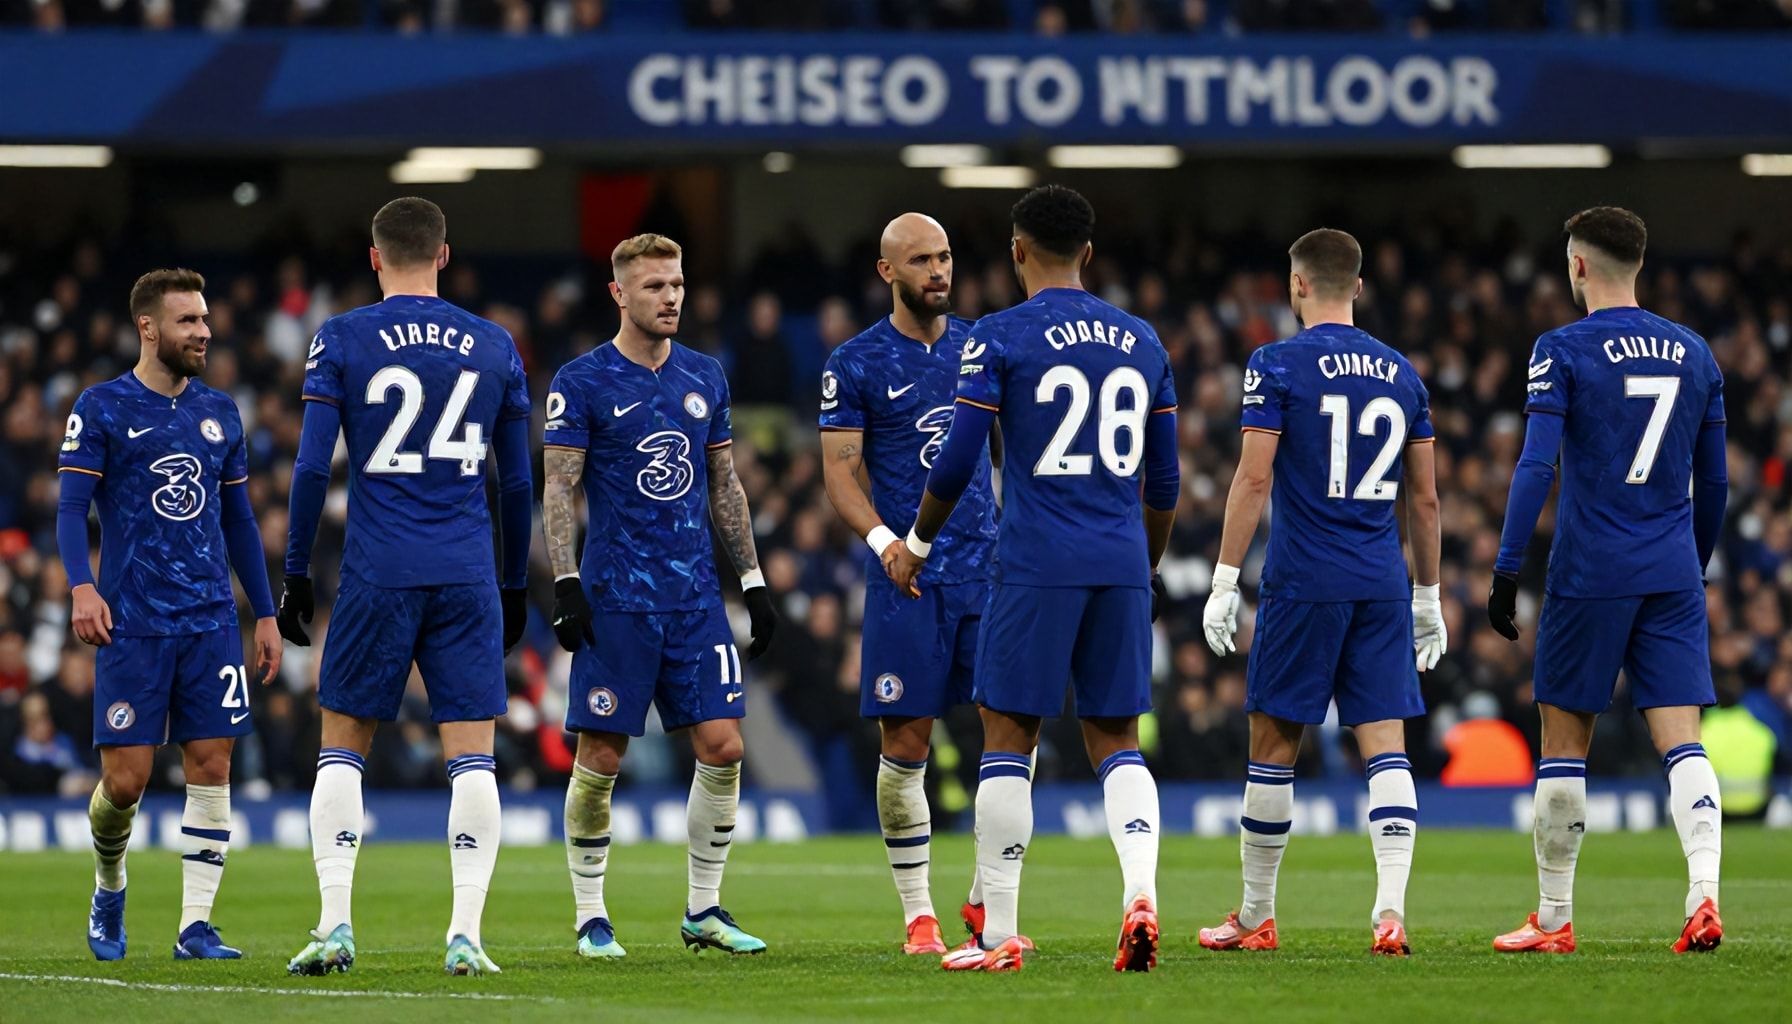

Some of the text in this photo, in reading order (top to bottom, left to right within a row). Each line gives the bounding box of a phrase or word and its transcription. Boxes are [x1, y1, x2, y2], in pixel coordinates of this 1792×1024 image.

[631, 57, 947, 125] CHEISEO
[973, 58, 1081, 125] TO
[363, 365, 488, 477] 24
[636, 430, 694, 501] 3
[1319, 394, 1407, 501] 12
[1623, 374, 1681, 485] 7
[149, 453, 206, 522] 3
